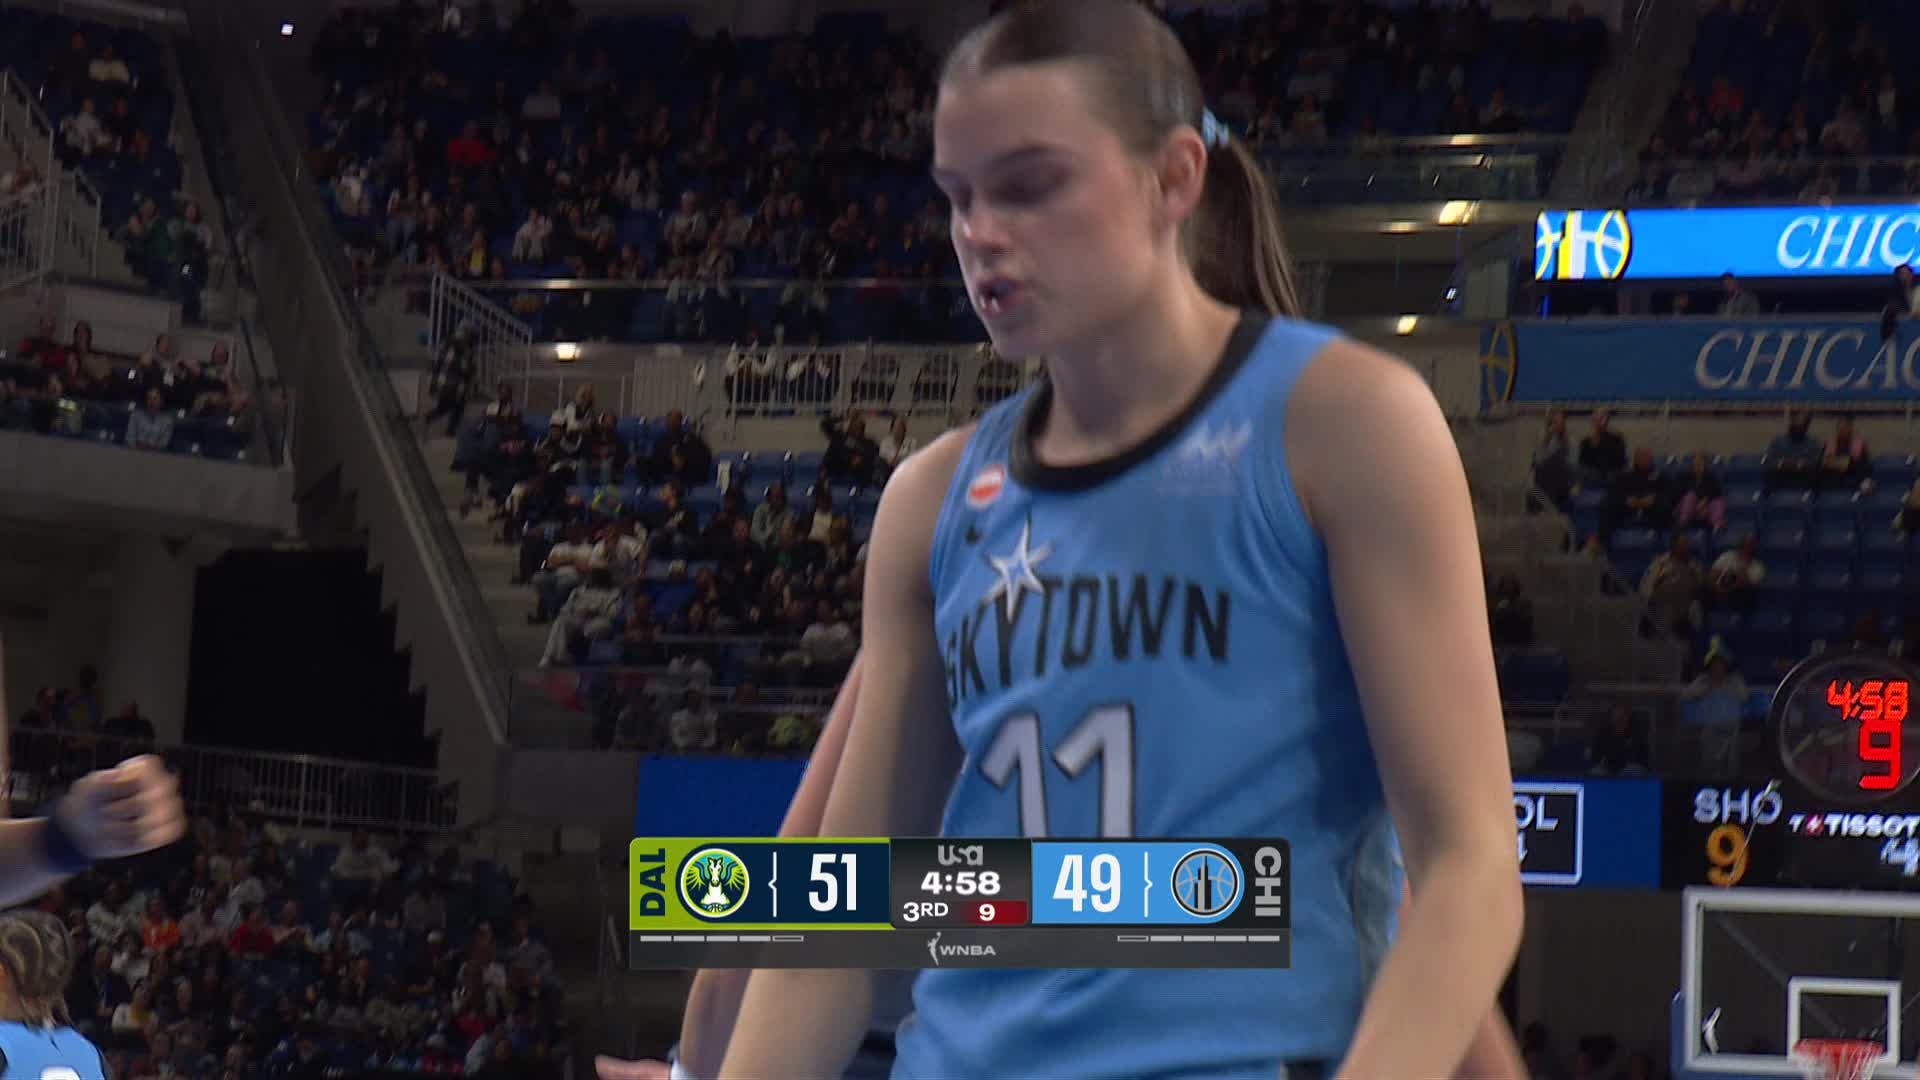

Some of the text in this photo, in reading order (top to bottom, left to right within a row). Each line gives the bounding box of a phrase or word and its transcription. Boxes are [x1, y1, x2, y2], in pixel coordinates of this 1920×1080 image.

[1776, 213, 1920, 269] CHIC
[945, 572, 1230, 711] SKYTOWN
[1827, 679, 1910, 721] 4:58
[979, 702, 1135, 838] 11
[1858, 721, 1903, 790] 9
[1706, 823, 1749, 887] 9
[1823, 814, 1920, 838] TISSOT
